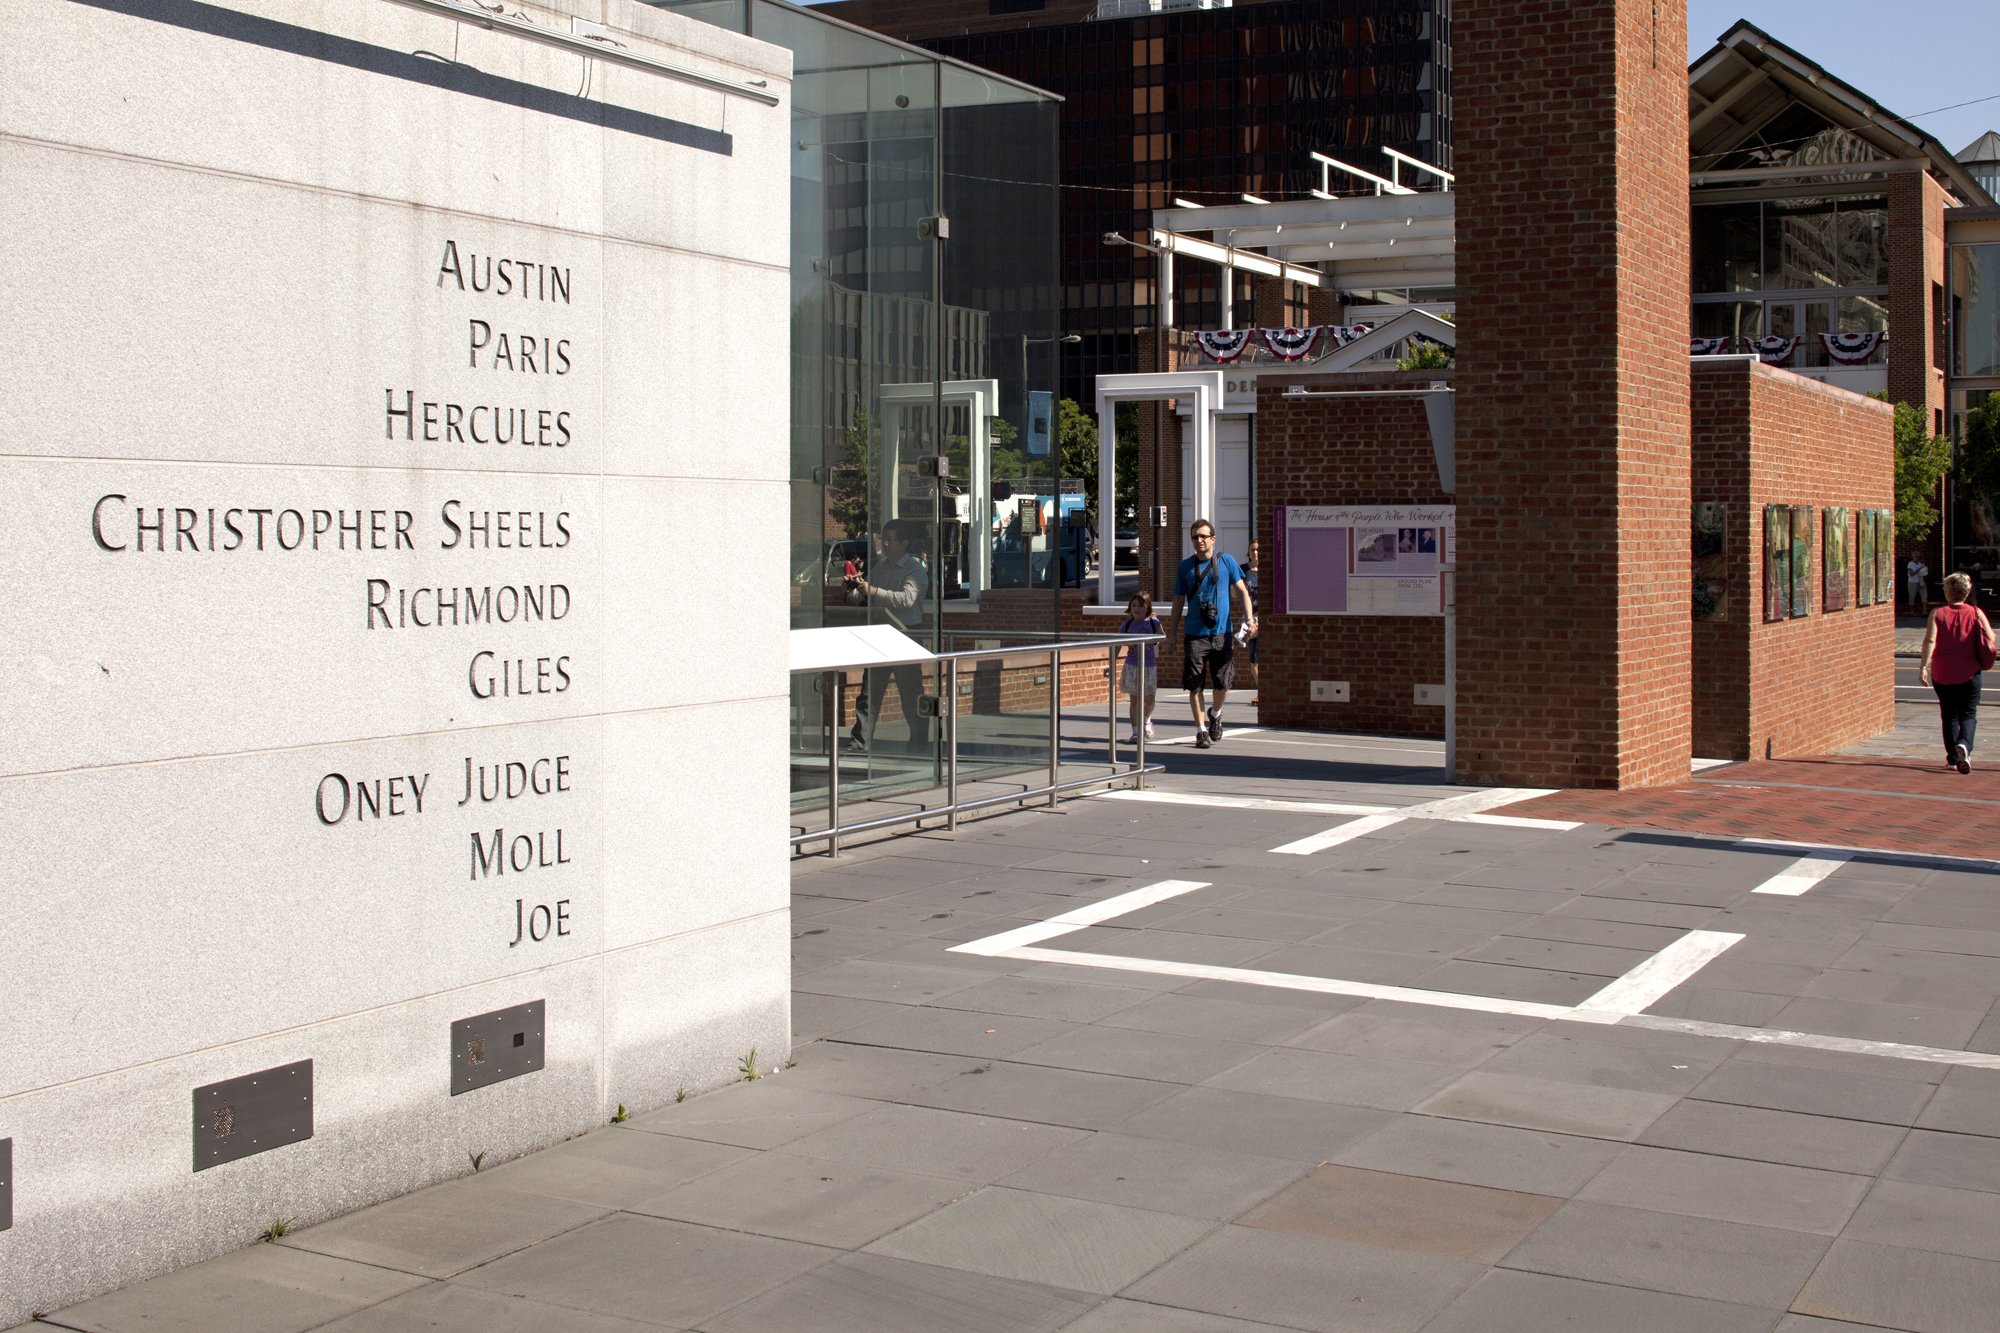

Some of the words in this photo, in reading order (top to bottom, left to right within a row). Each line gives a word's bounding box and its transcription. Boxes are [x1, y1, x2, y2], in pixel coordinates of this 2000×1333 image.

[438, 239, 571, 304] AUSTIN
[470, 319, 571, 375] PARIS
[386, 390, 571, 447] HERCULES
[91, 493, 416, 553] CHRISTOPHER
[441, 499, 571, 549] SHEELS
[1305, 508, 1334, 523] House
[1351, 511, 1381, 524] People
[1384, 509, 1405, 521] Who
[1408, 508, 1445, 523] Worked
[366, 578, 570, 630] RICHMOND
[469, 650, 571, 700] GILES
[315, 772, 429, 826] ONEY
[458, 755, 571, 807] JUDGE
[470, 828, 571, 880] MOLL
[509, 898, 571, 948] JOE
